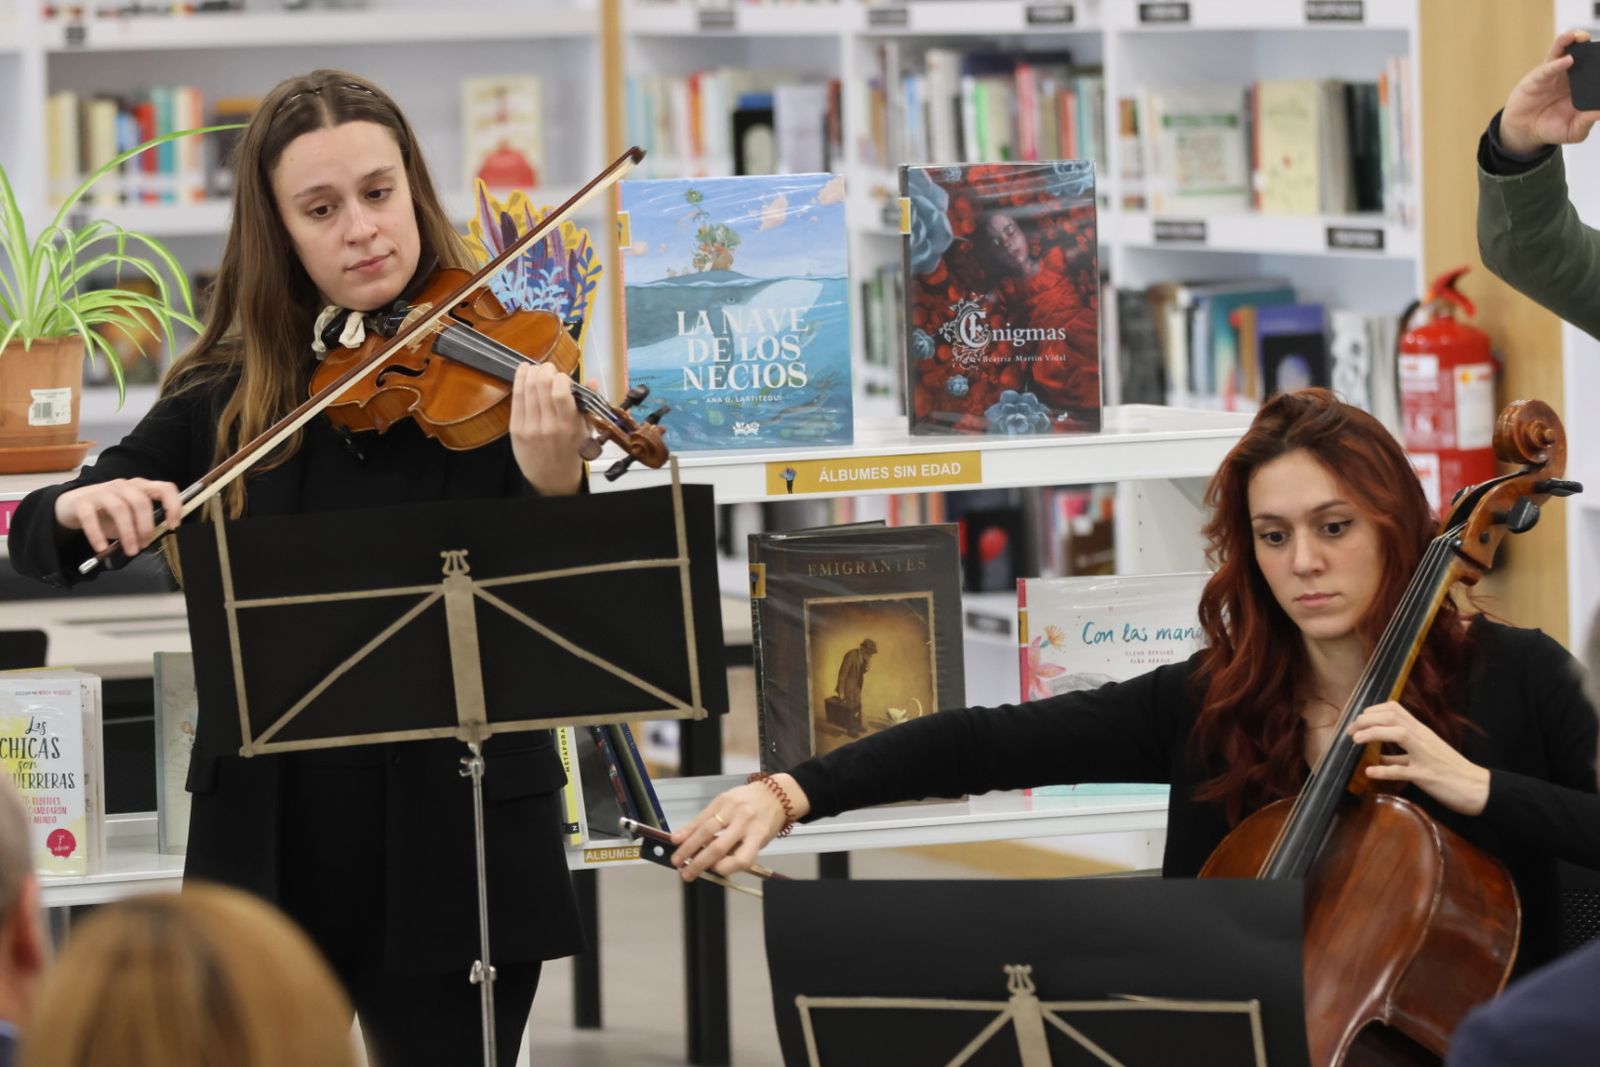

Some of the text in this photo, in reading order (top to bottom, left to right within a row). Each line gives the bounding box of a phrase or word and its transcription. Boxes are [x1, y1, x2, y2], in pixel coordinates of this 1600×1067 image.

[676, 306, 809, 336] LA NAVE
[959, 310, 1067, 349] Enigmas
[687, 335, 801, 362] DE LOS
[682, 362, 808, 391] NECIOS
[819, 462, 961, 483] ÁLBUMES SIN EDAD
[808, 558, 927, 577] EMIGRANTES
[1082, 621, 1115, 645] Con
[1122, 623, 1148, 642] las
[25, 716, 47, 736] Las
[0, 736, 61, 760] CHICAS
[17, 759, 38, 773] son
[8, 772, 76, 790] UERRERAS
